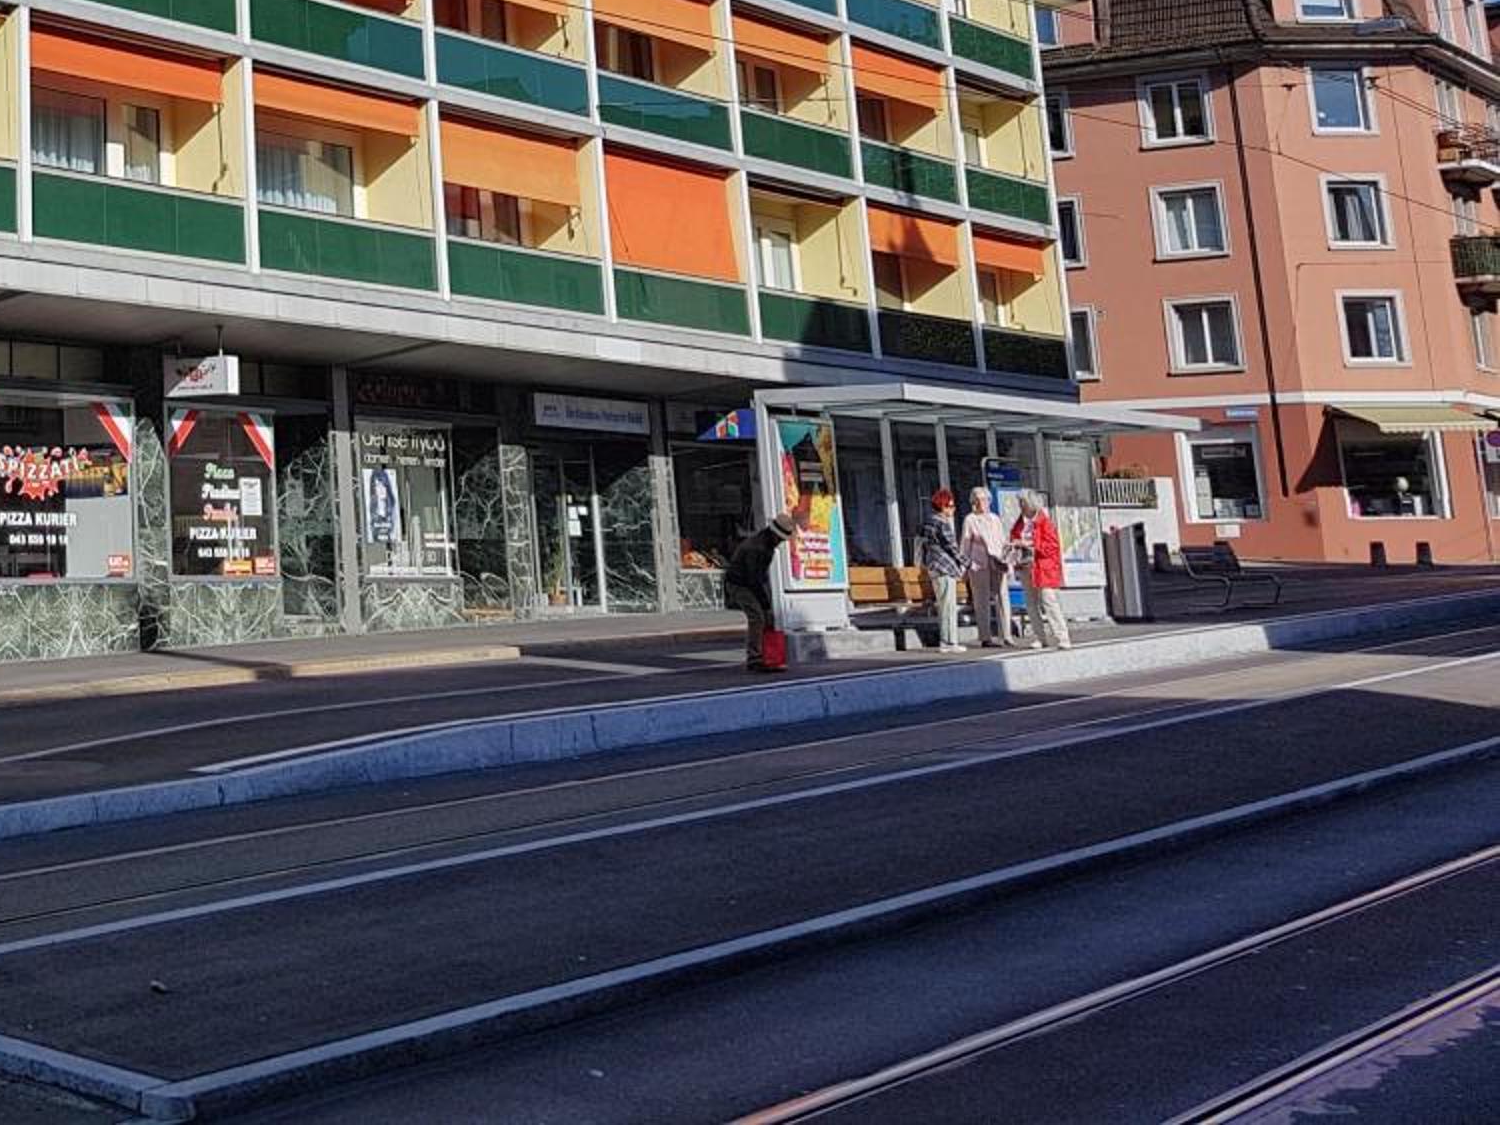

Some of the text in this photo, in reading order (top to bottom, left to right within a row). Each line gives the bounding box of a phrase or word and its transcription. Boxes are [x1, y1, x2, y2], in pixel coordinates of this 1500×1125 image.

[0, 512, 77, 527] PIZZA KURIER
[189, 527, 218, 540] PIZZA
